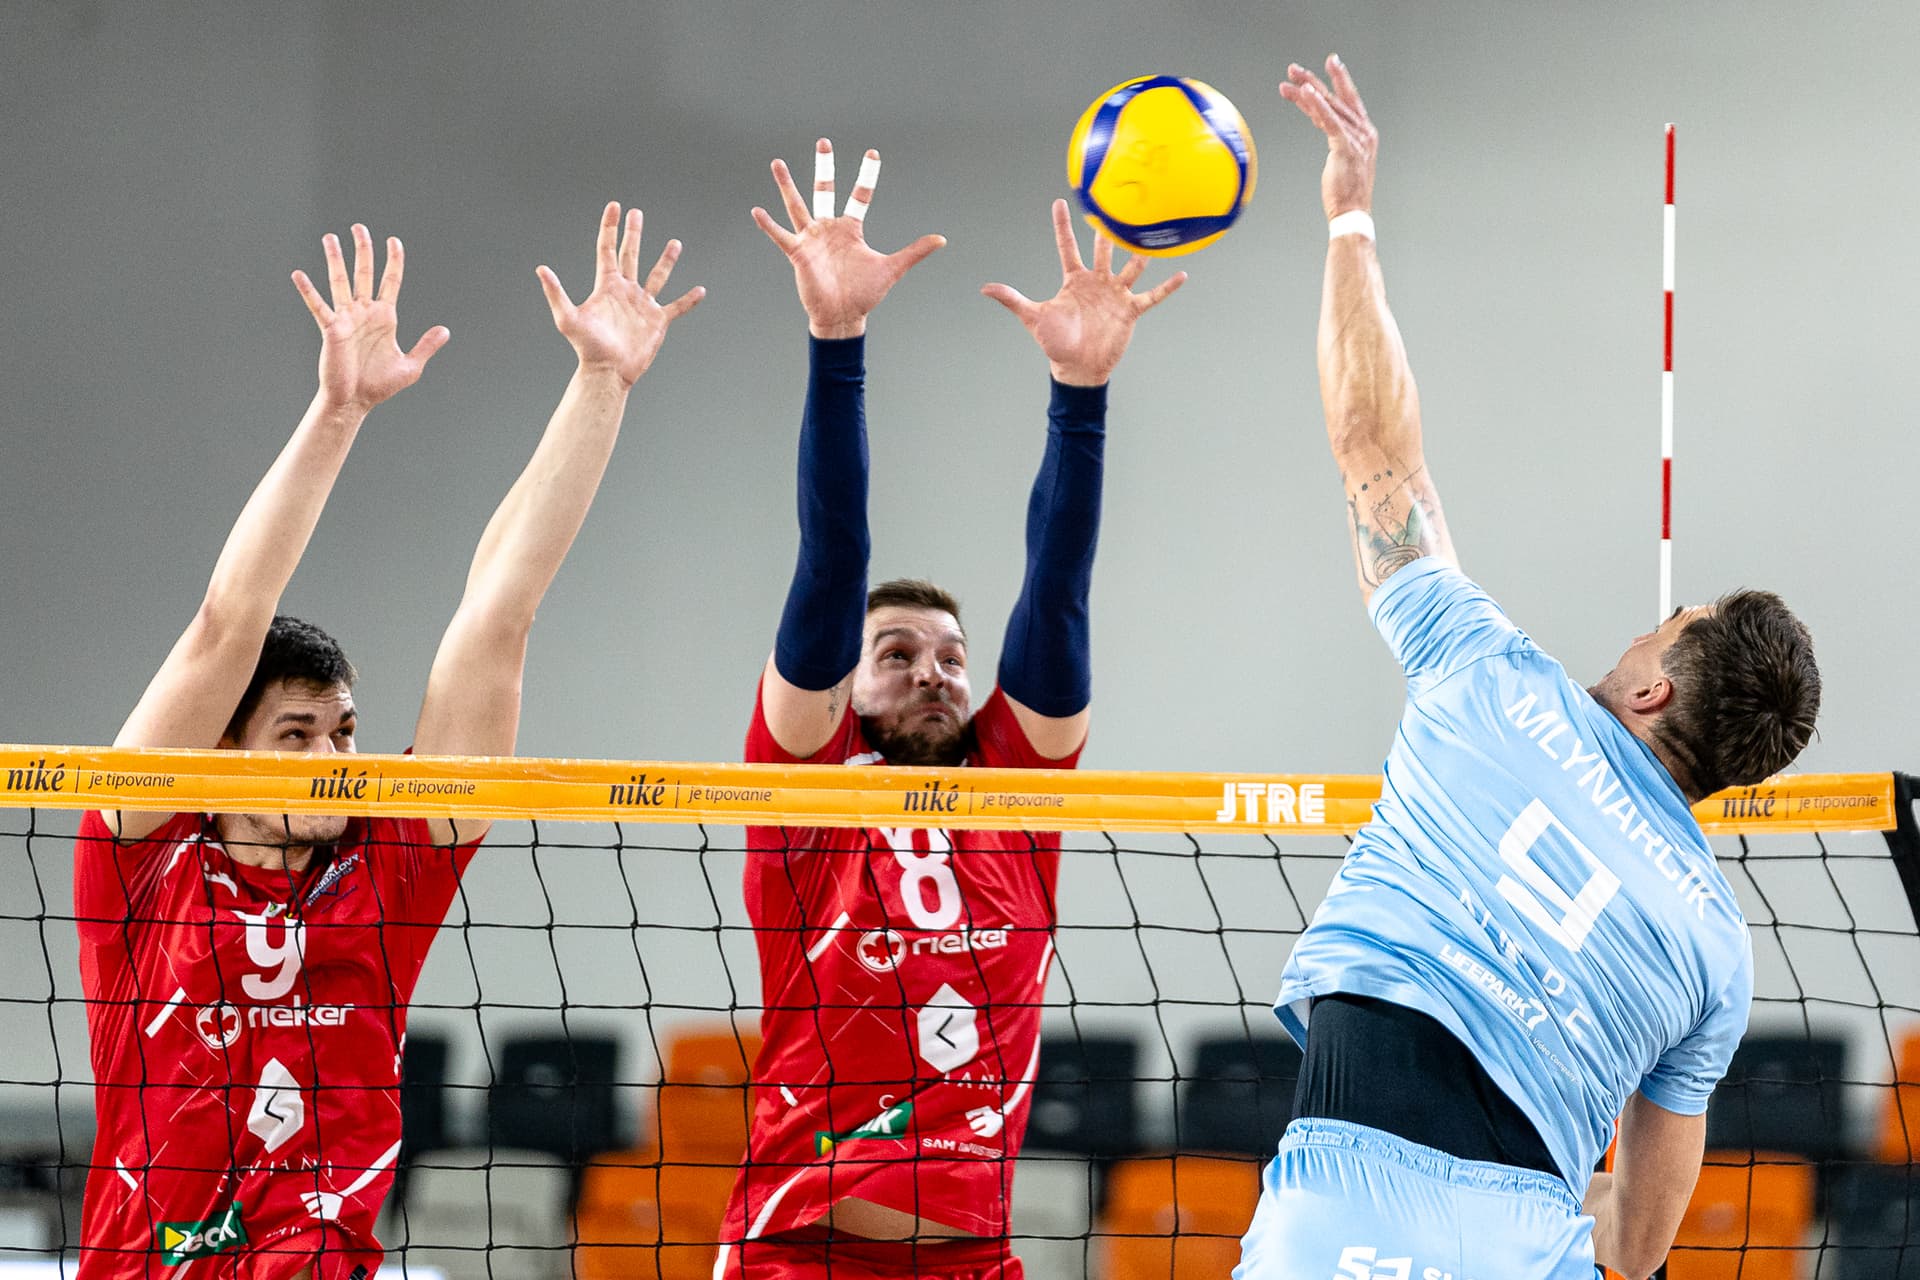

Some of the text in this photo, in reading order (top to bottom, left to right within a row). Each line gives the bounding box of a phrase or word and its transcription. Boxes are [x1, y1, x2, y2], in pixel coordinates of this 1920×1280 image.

[7, 759, 175, 792] niké je tipovanie
[310, 767, 476, 800] niké je tipovanie
[608, 774, 772, 806] niké je tipovanie
[903, 781, 1065, 812] niké je tipovanie
[1216, 782, 1325, 824] JTRE
[1723, 787, 1879, 819] niké je tipovanie
[880, 827, 963, 931] 8
[1495, 796, 1623, 952] 9
[236, 908, 307, 1001] 9
[911, 923, 1015, 956] rieker
[247, 994, 355, 1029] rieker
[922, 1137, 956, 1152] SAM
